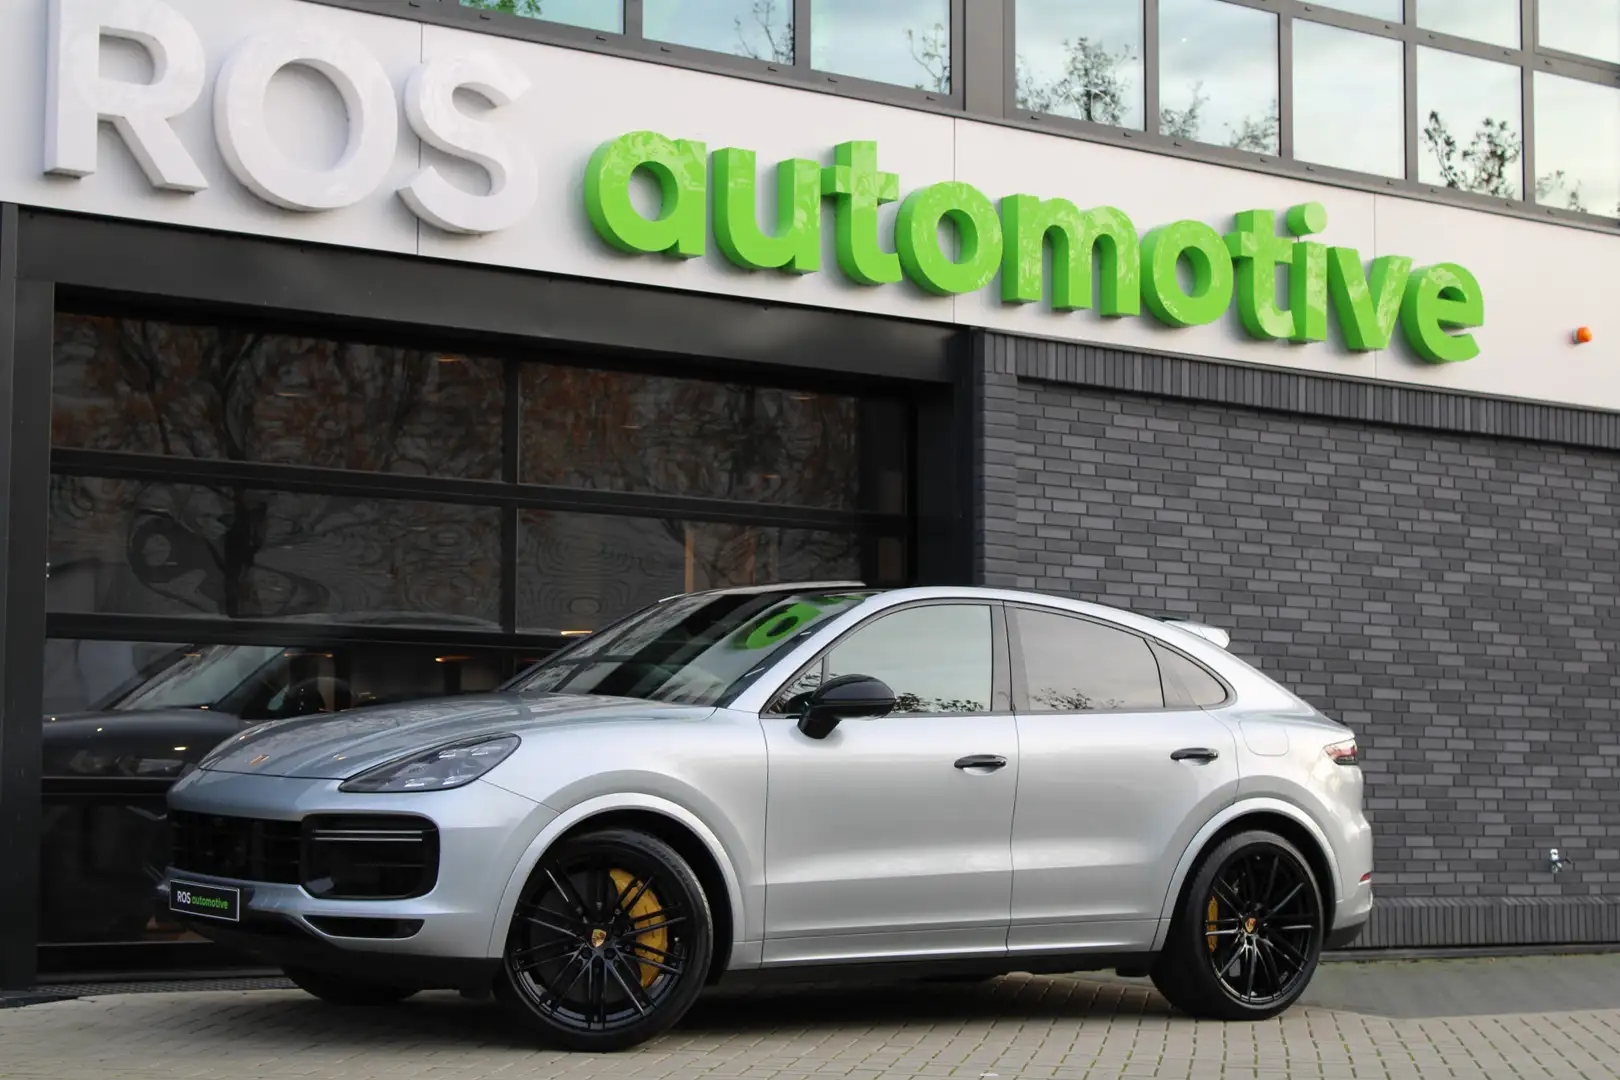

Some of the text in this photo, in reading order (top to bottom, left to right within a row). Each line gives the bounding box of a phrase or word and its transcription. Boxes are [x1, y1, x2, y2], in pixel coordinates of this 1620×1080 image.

[44, 0, 1484, 364] ROS automotive
[177, 890, 229, 910] ROS automotive
